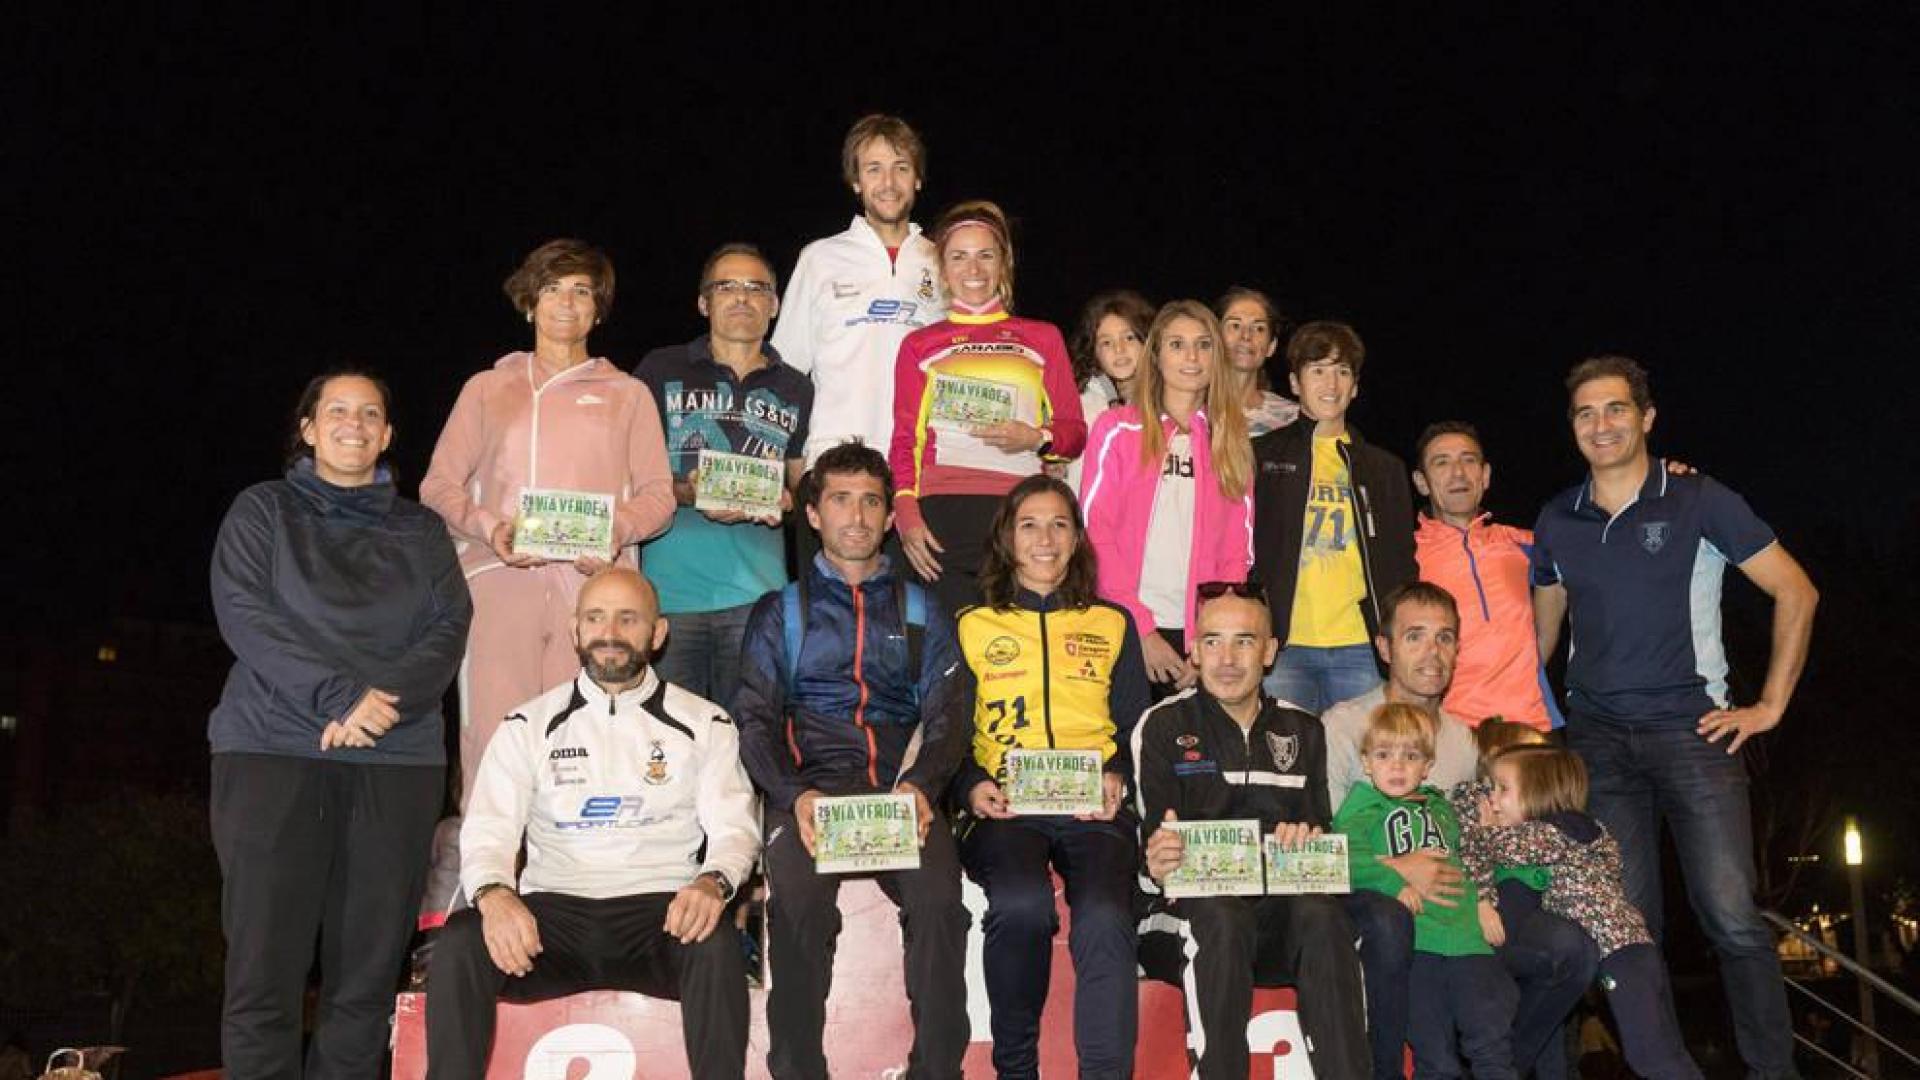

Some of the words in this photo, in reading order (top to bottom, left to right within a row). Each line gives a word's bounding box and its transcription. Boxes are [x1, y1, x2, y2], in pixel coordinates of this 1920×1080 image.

[1304, 506, 1346, 551] 71
[985, 696, 1030, 733] 71
[549, 747, 590, 760] oma
